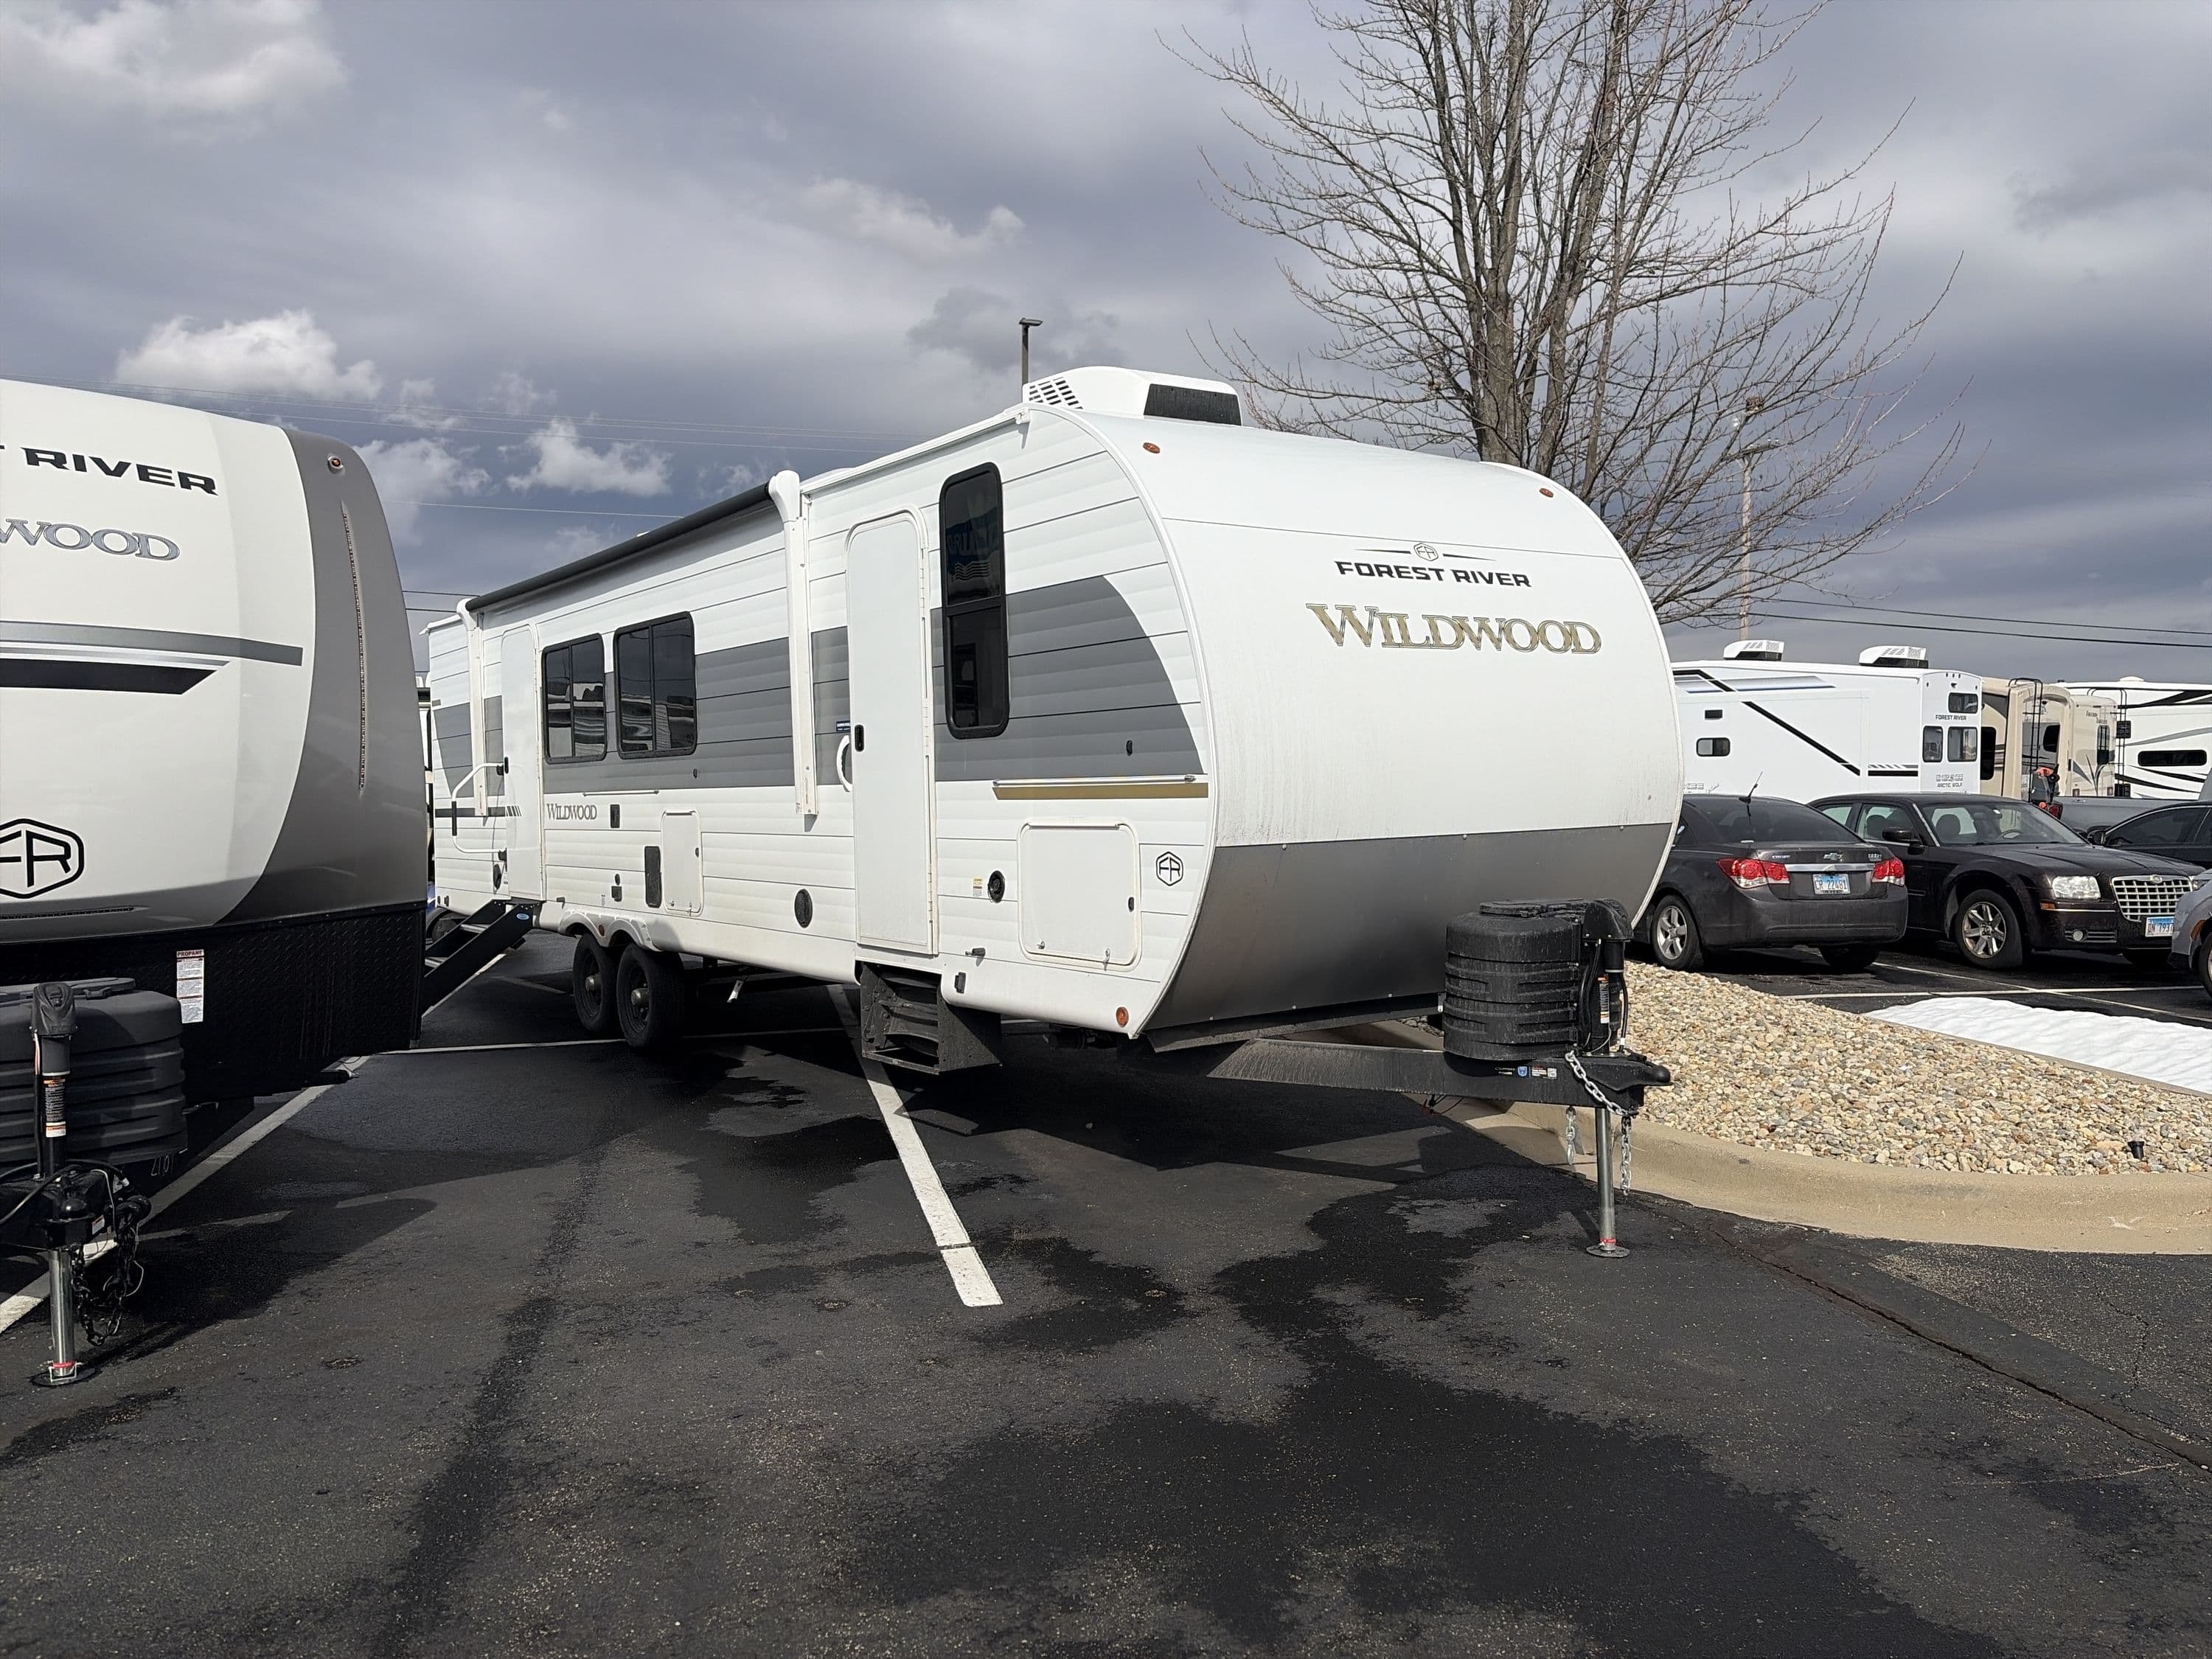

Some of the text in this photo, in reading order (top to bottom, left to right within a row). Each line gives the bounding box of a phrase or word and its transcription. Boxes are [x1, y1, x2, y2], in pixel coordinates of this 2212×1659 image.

[20, 447, 218, 496] RIVER
[1334, 561, 1532, 588] FOREST RIVER
